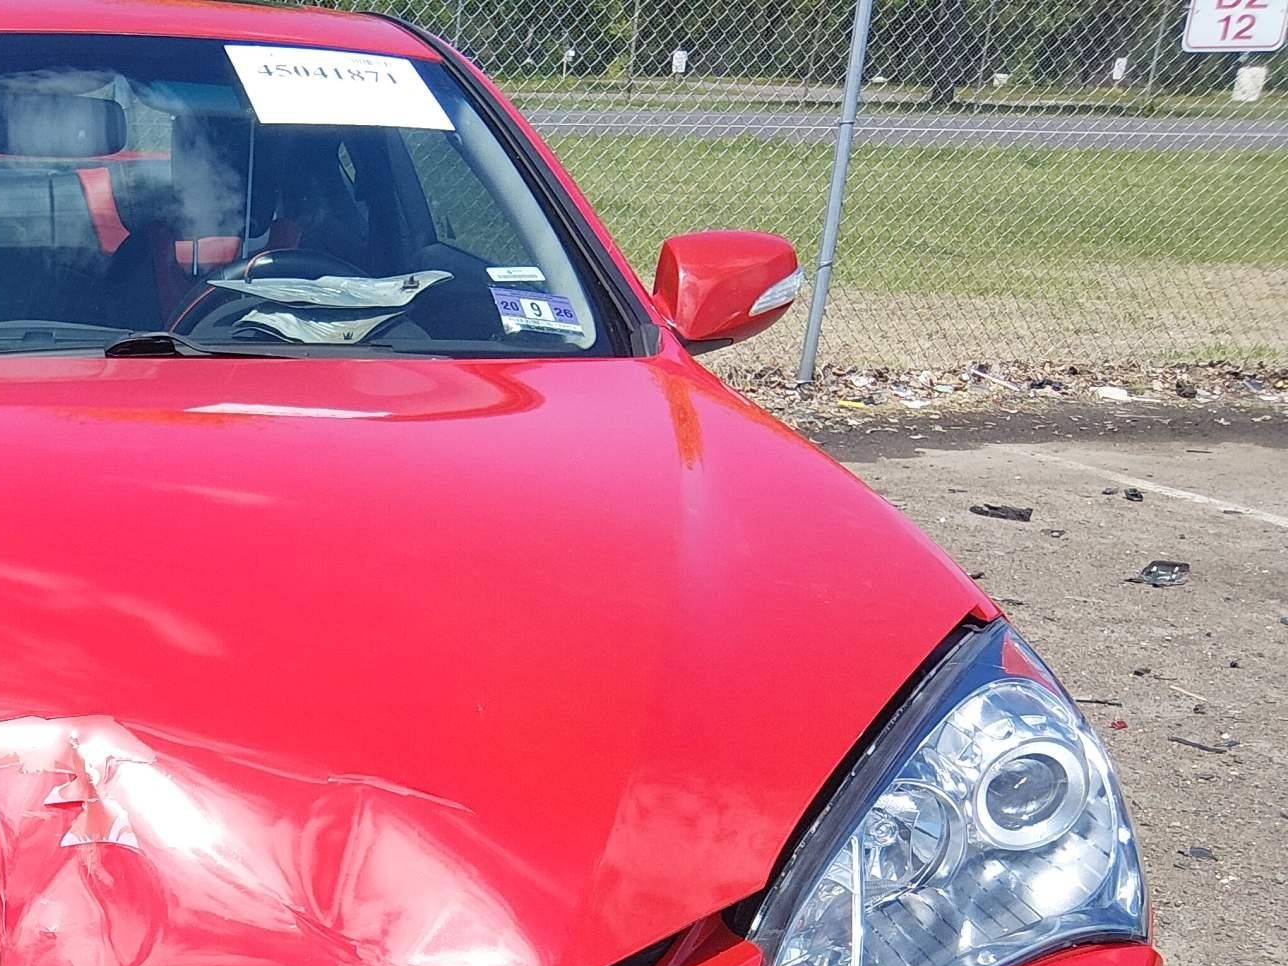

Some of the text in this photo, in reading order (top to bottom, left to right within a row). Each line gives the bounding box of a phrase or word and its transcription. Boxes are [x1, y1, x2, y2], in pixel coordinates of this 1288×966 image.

[1217, 14, 1256, 41] 12
[257, 64, 397, 84] 45041871
[500, 300, 573, 319] 20 9 26
